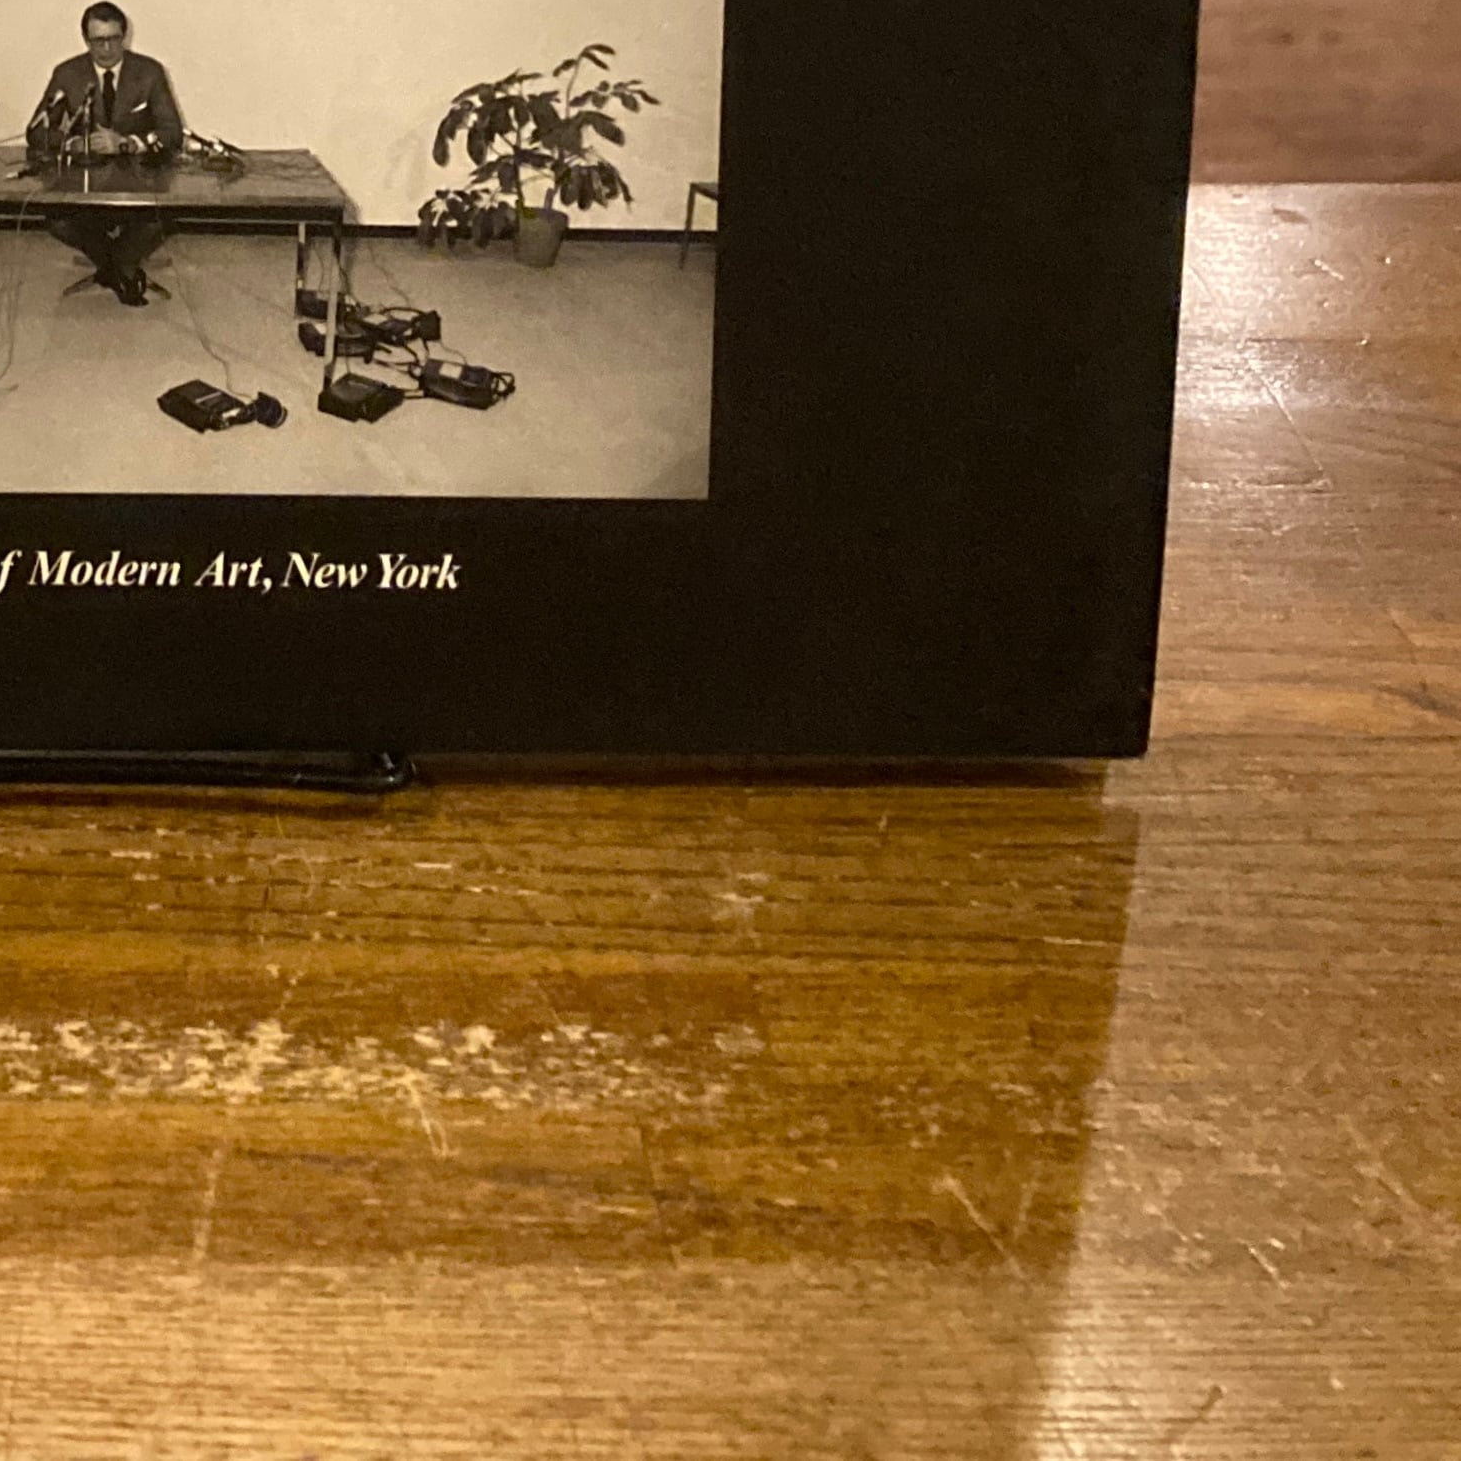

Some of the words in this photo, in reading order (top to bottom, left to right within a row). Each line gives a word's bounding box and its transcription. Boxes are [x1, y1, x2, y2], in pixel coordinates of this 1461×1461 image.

[28, 551, 181, 587] Modern
[195, 551, 273, 593] Art,
[282, 552, 368, 589] New
[379, 553, 461, 590] York
